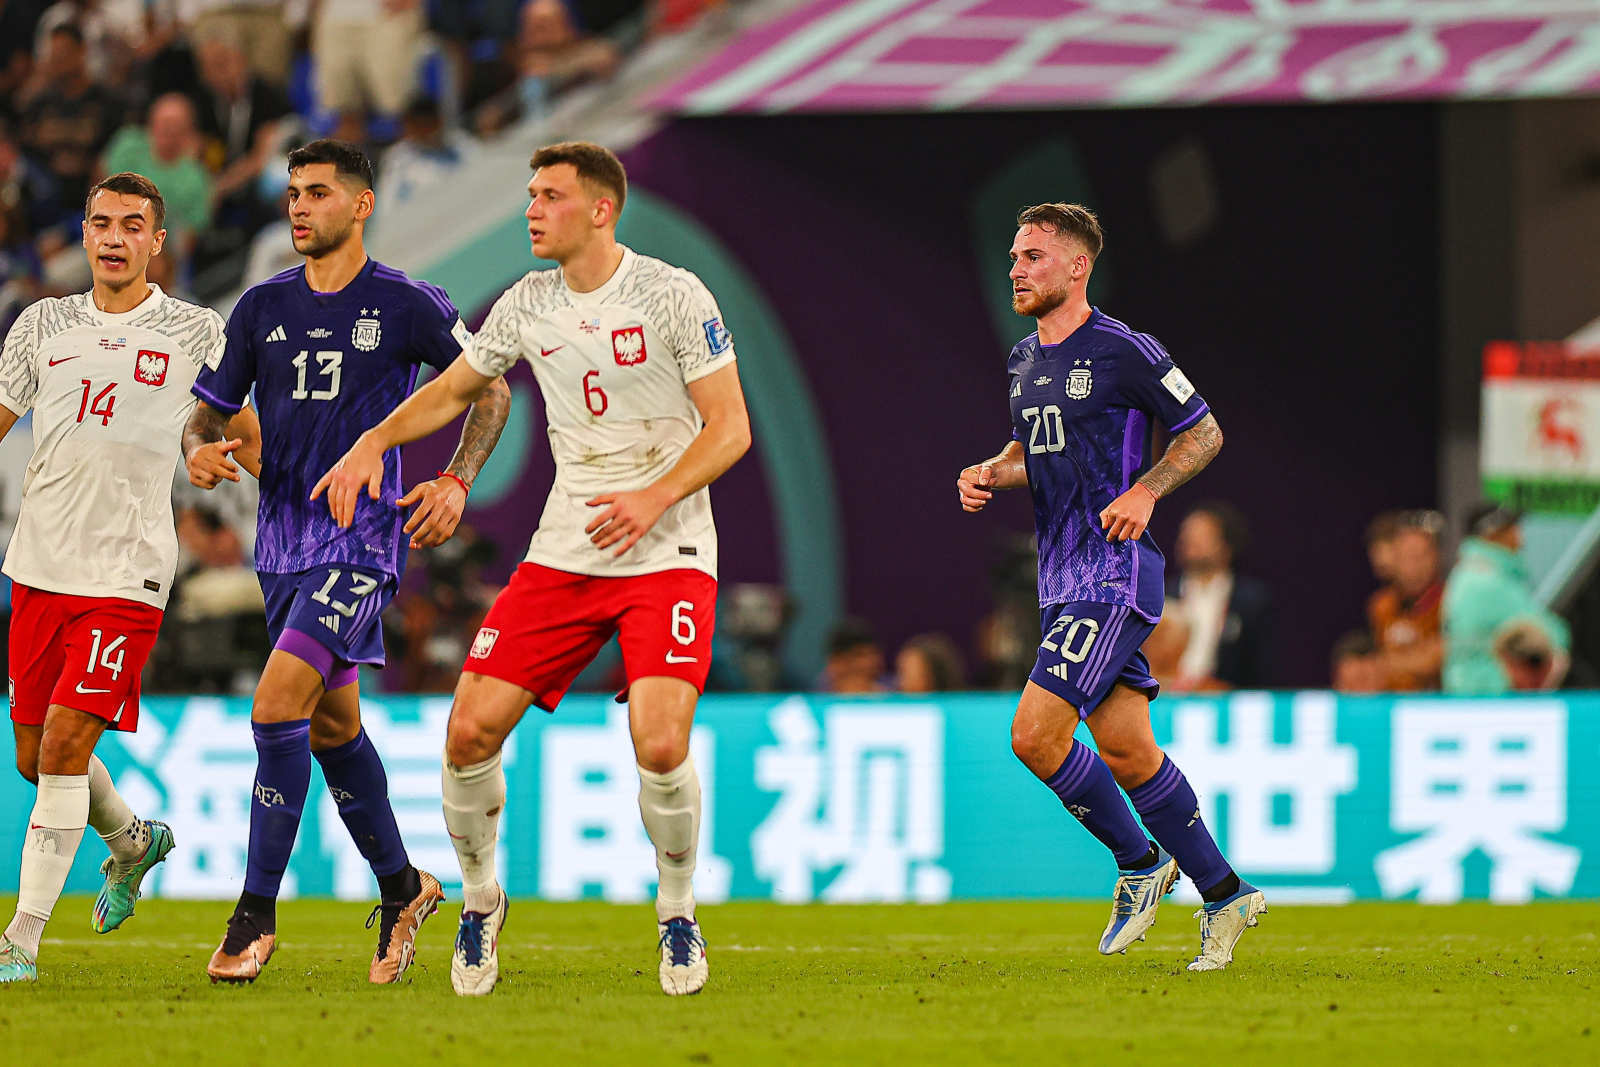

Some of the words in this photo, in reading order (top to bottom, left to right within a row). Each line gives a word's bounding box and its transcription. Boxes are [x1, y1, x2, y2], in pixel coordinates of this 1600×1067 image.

[291, 350, 344, 401] 13
[582, 370, 608, 416] 6
[77, 379, 118, 427] 14
[1021, 404, 1066, 455] 20
[311, 568, 378, 618] 13
[671, 600, 697, 646] 6
[1040, 615, 1100, 664] 20
[86, 629, 128, 681] 14
[1164, 691, 1582, 905] 世界
